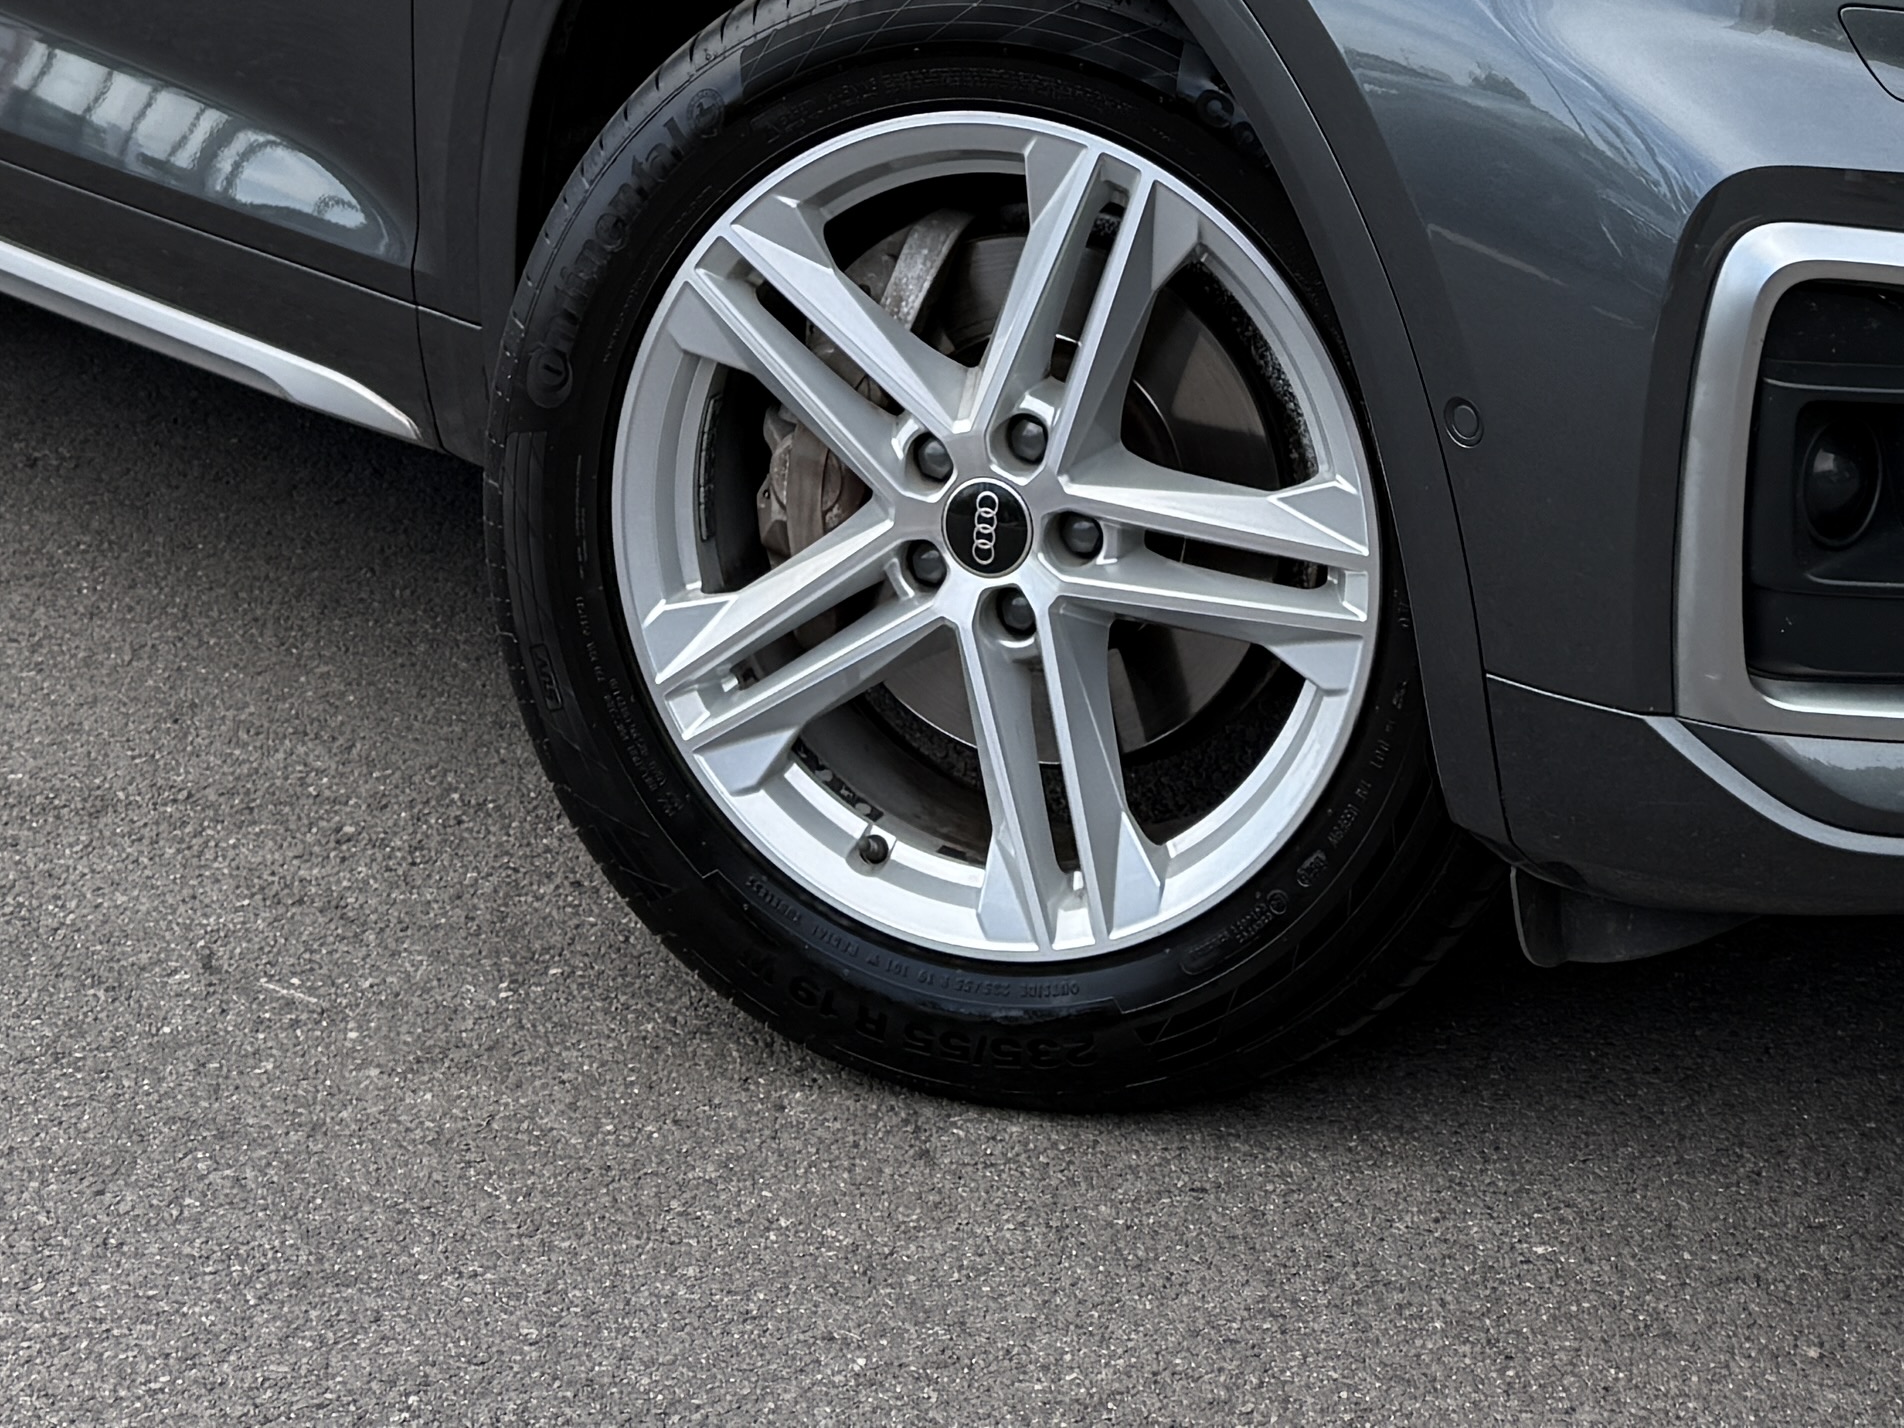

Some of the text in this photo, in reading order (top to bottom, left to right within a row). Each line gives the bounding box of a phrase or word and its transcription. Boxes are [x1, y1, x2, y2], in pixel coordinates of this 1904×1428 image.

[787, 975, 840, 1020] 19
[854, 1003, 888, 1048] R
[901, 1021, 1098, 1071] 235/55
